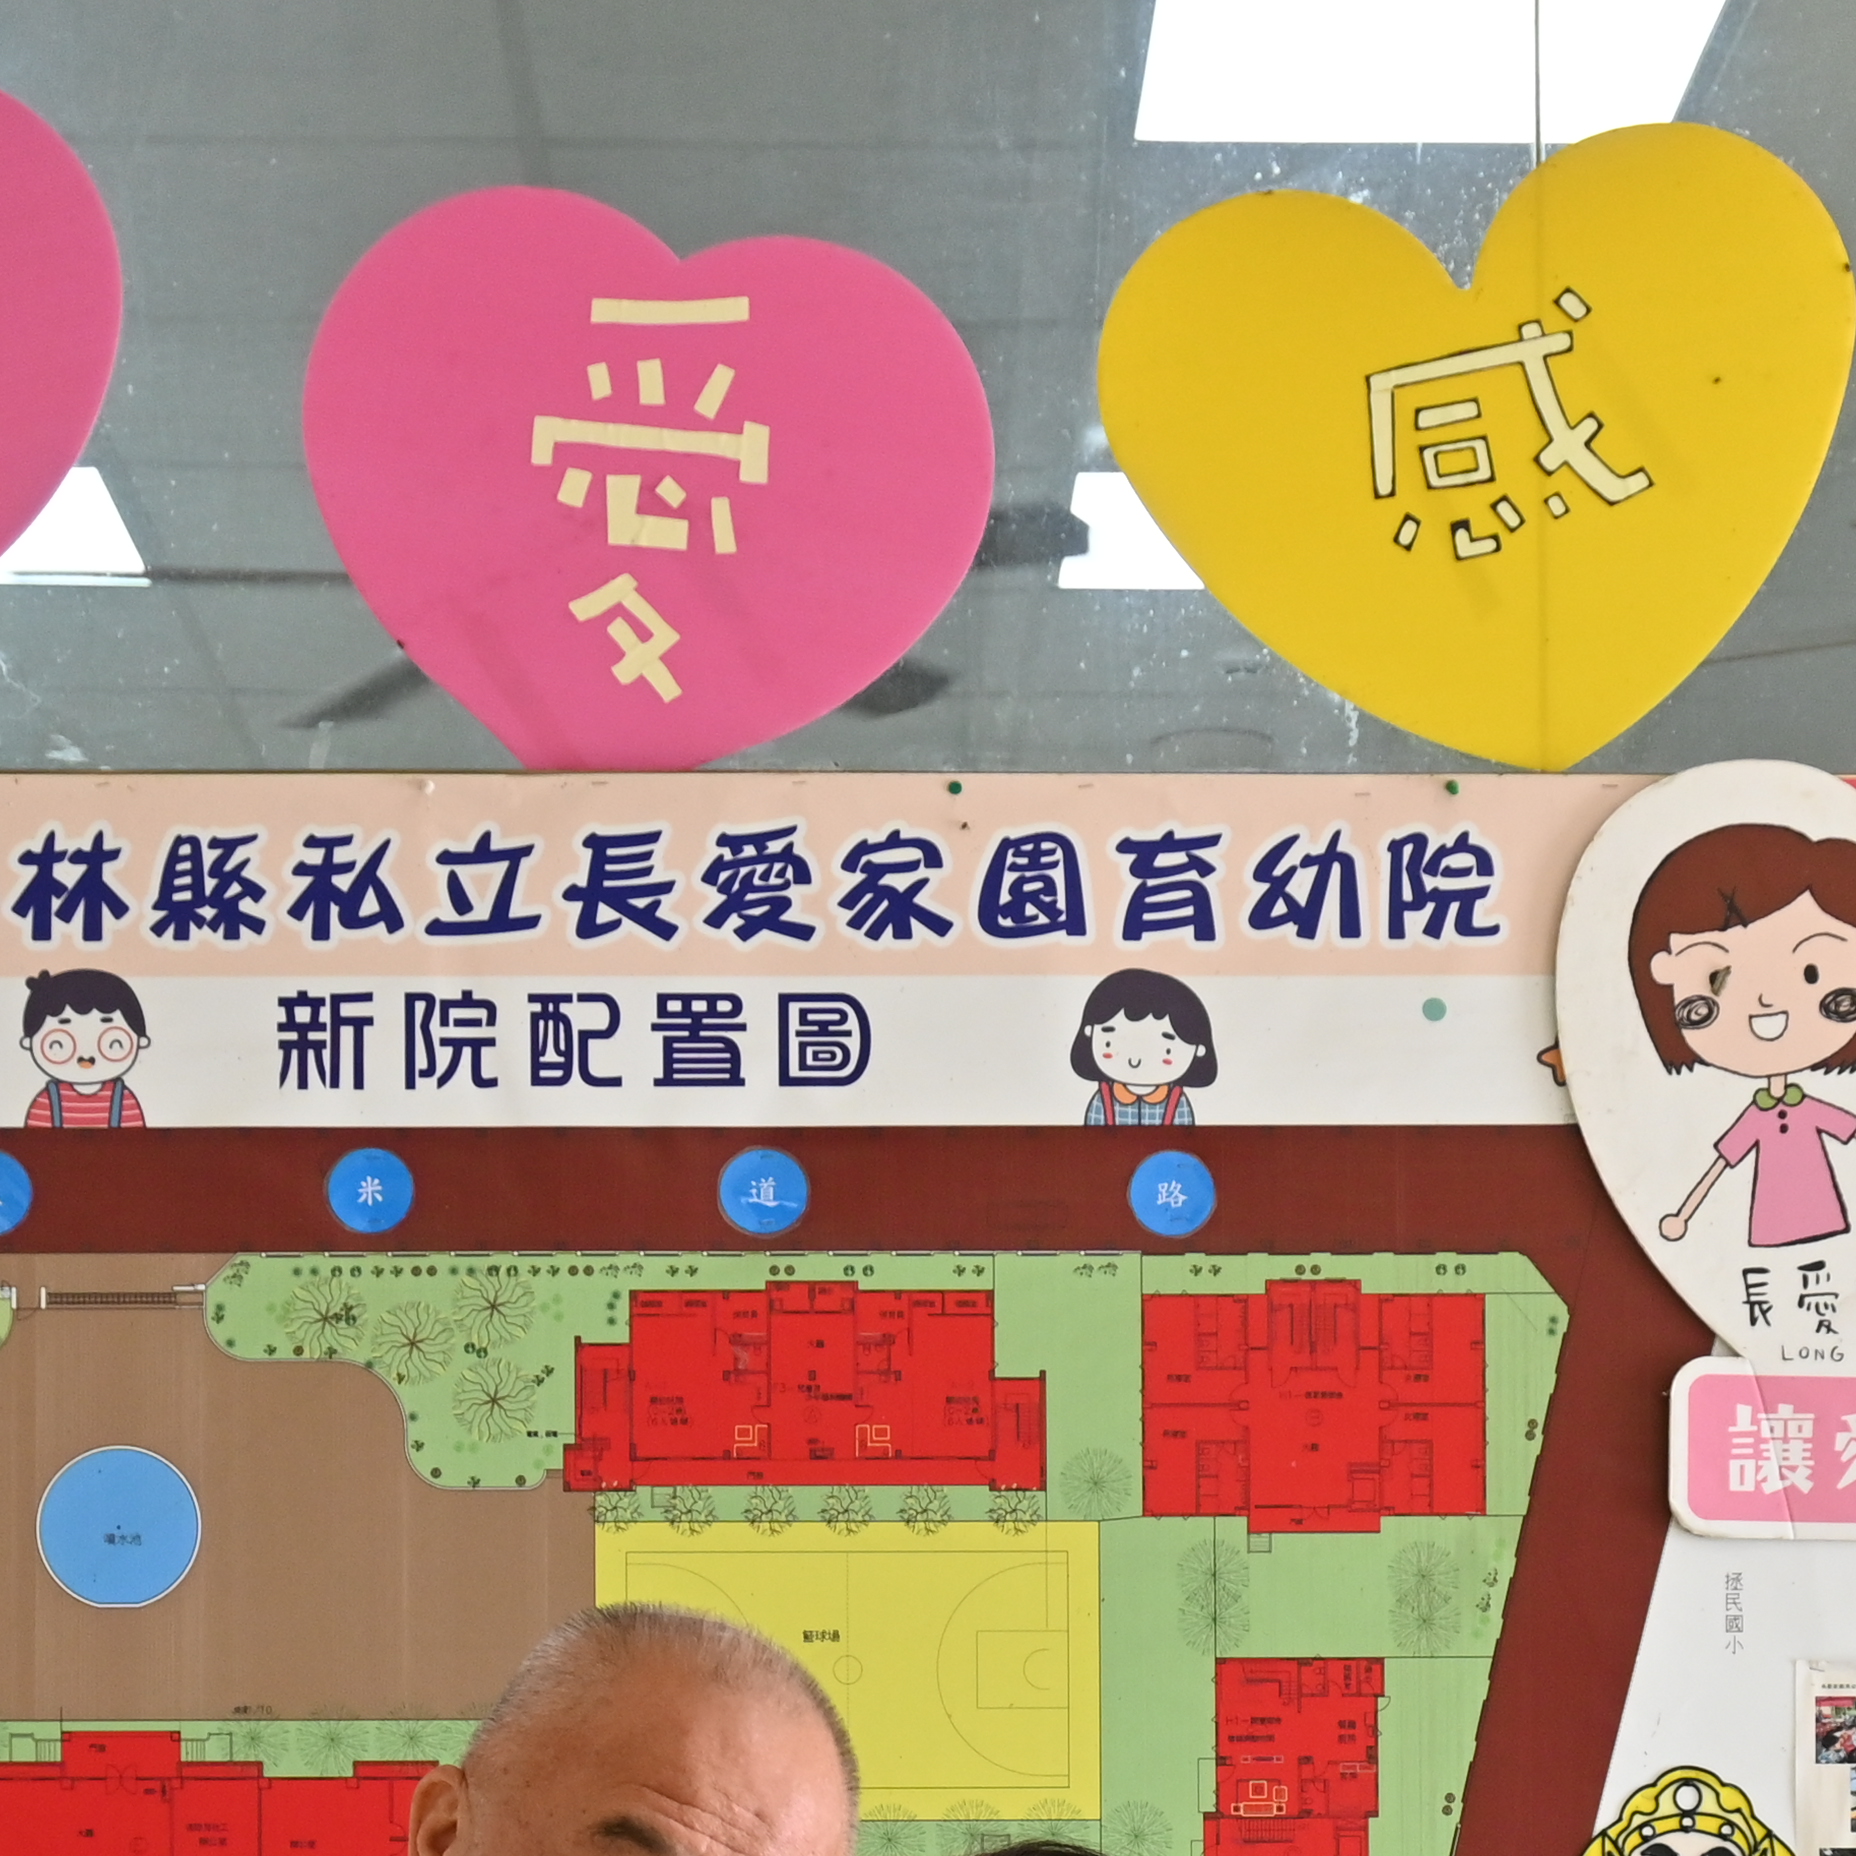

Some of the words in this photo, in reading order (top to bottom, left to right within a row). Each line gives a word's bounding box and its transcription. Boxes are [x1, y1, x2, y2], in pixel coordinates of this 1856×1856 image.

[531, 297, 769, 703] 愛
[1369, 287, 1654, 560] 感
[277, 990, 871, 1091] 新院配置圖
[749, 1177, 798, 1208] 道
[1157, 1178, 1188, 1208] 路
[1781, 1345, 1845, 1365] LONG
[803, 1630, 840, 1643] 籃球場
[1724, 1572, 1744, 1655] 拯民國小
